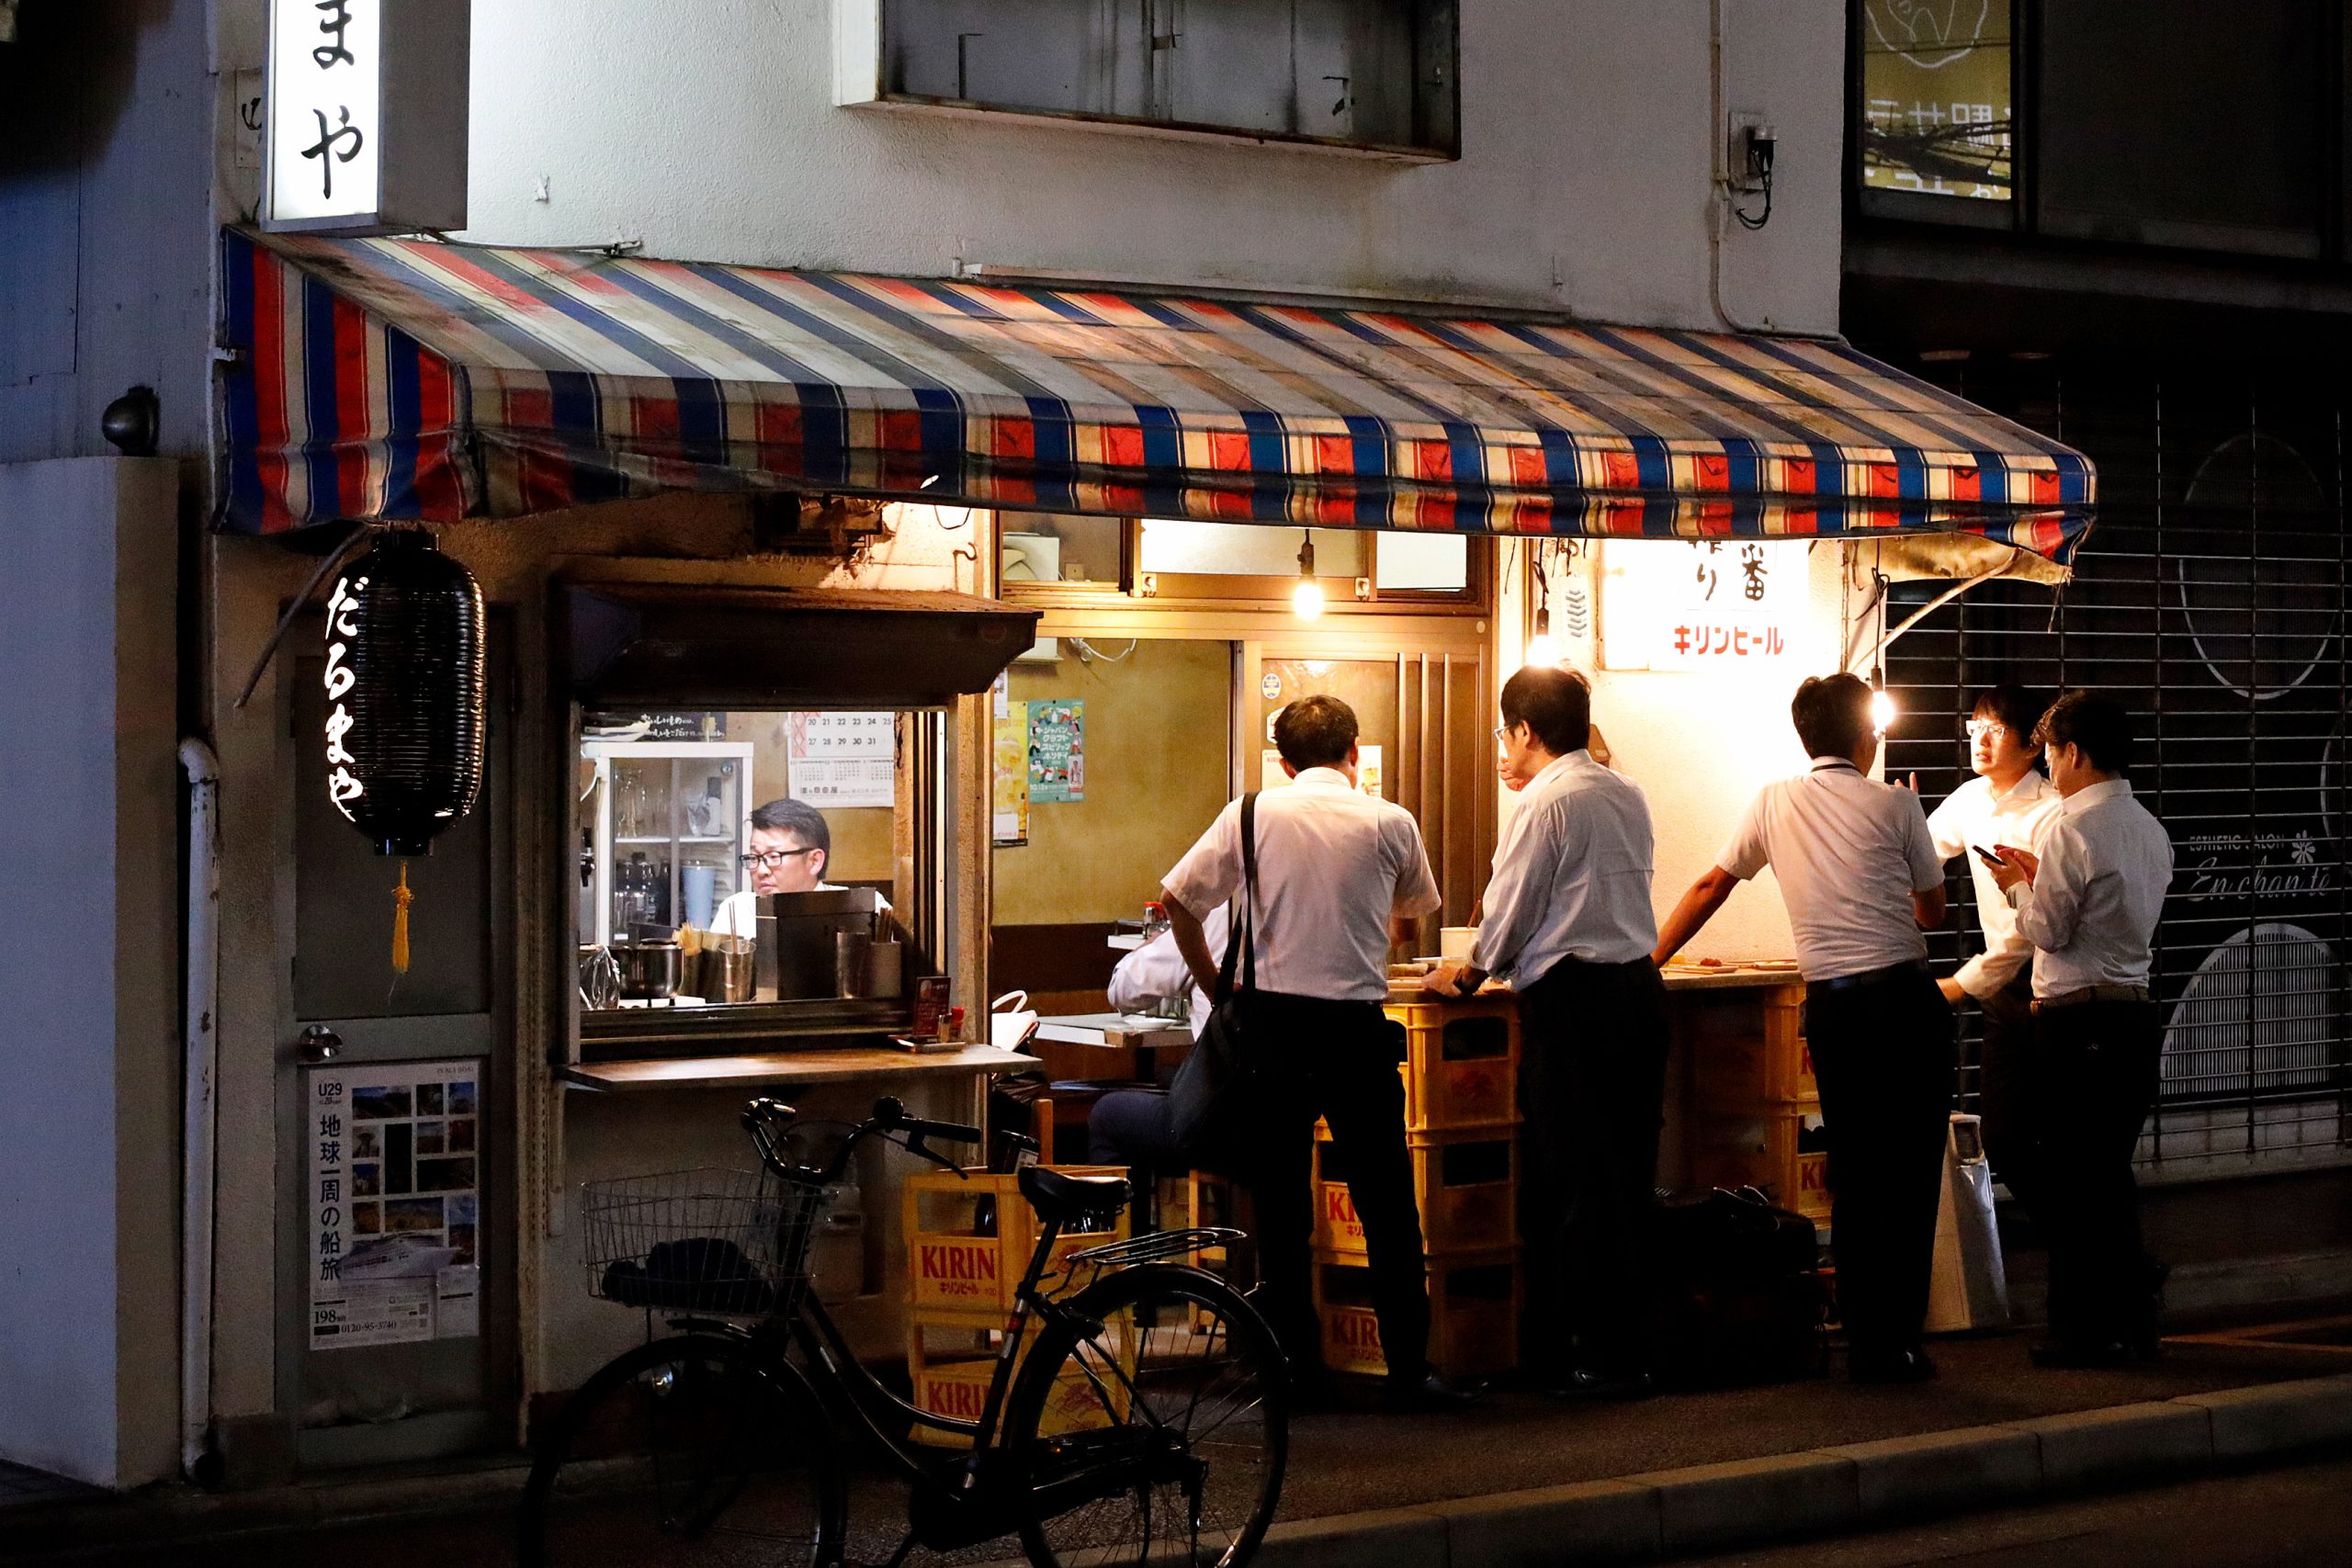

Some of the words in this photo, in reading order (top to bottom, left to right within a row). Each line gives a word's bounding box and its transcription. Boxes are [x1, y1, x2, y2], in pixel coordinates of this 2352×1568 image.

[1674, 625, 1784, 656] キリンビール
[323, 576, 369, 822] だるまや
[319, 1082, 343, 1096] U29
[320, 1113, 342, 1281] 地球一周の船旅
[921, 1245, 995, 1280] KIRIN
[928, 1381, 990, 1416] KIRI
